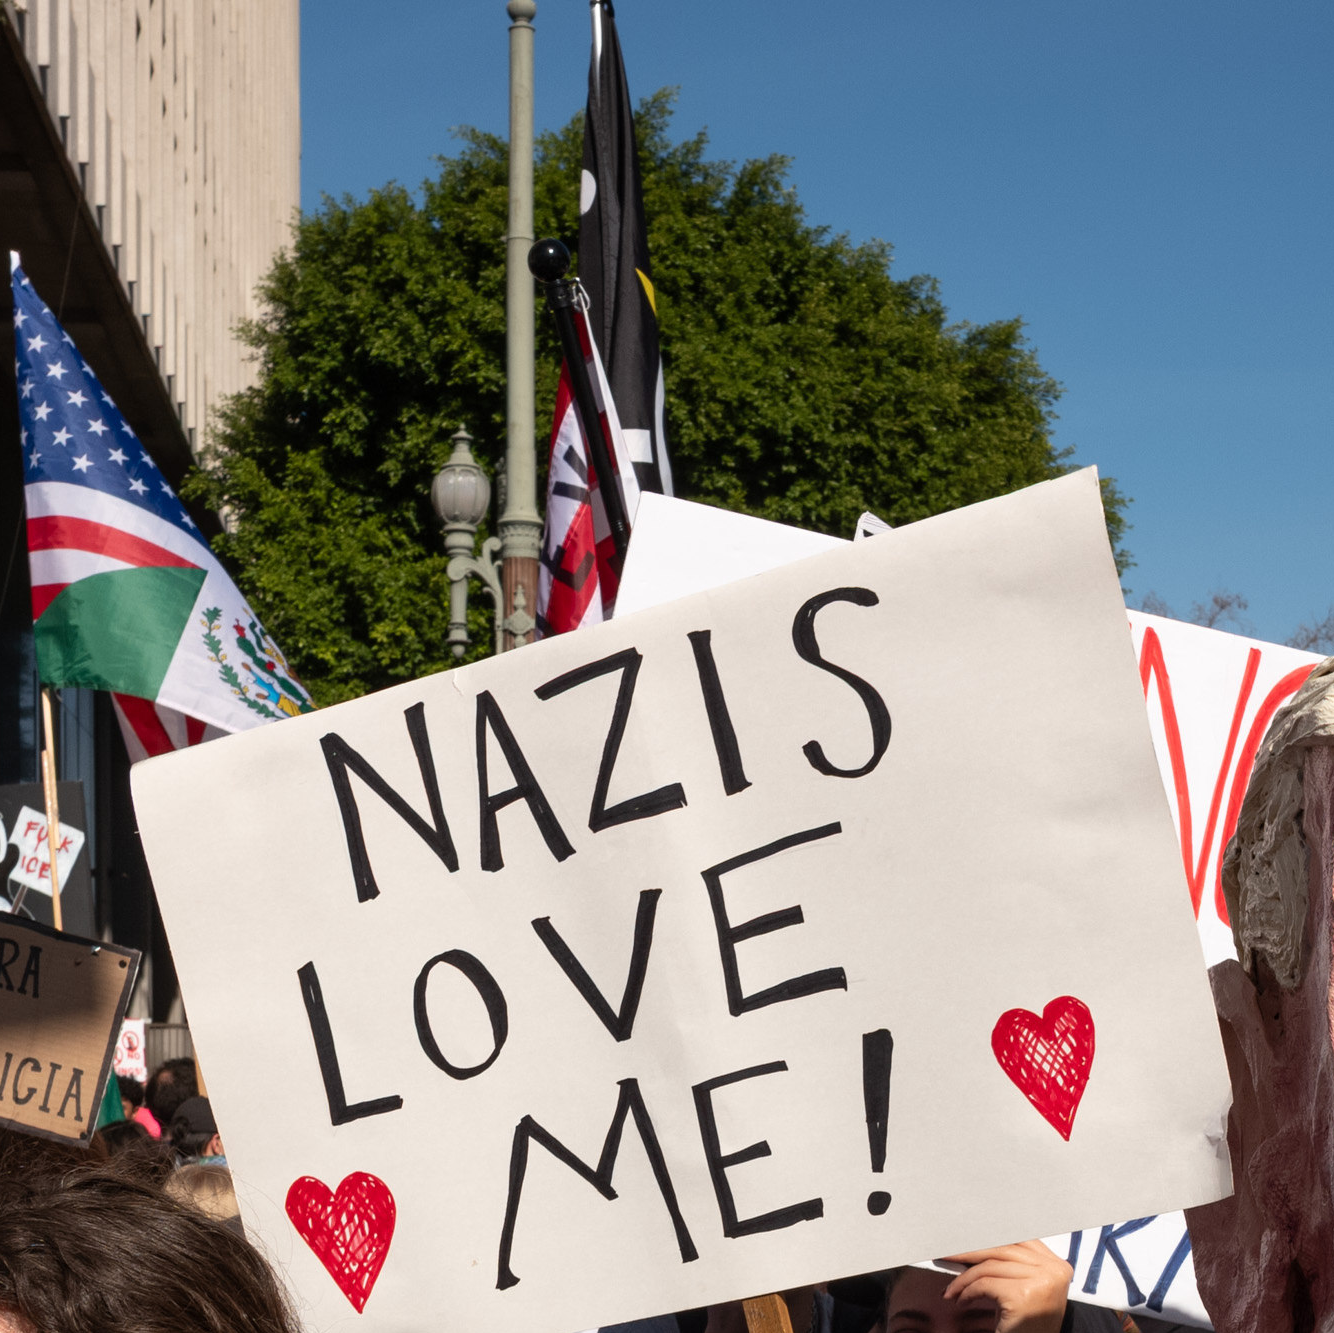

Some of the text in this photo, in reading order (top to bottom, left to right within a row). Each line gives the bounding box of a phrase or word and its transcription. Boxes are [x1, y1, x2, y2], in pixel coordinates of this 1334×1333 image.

[20, 855, 53, 879] ICE
[320, 586, 892, 903] NAZIS
[296, 820, 849, 1126] LOVE
[496, 1028, 895, 1291] ME!
